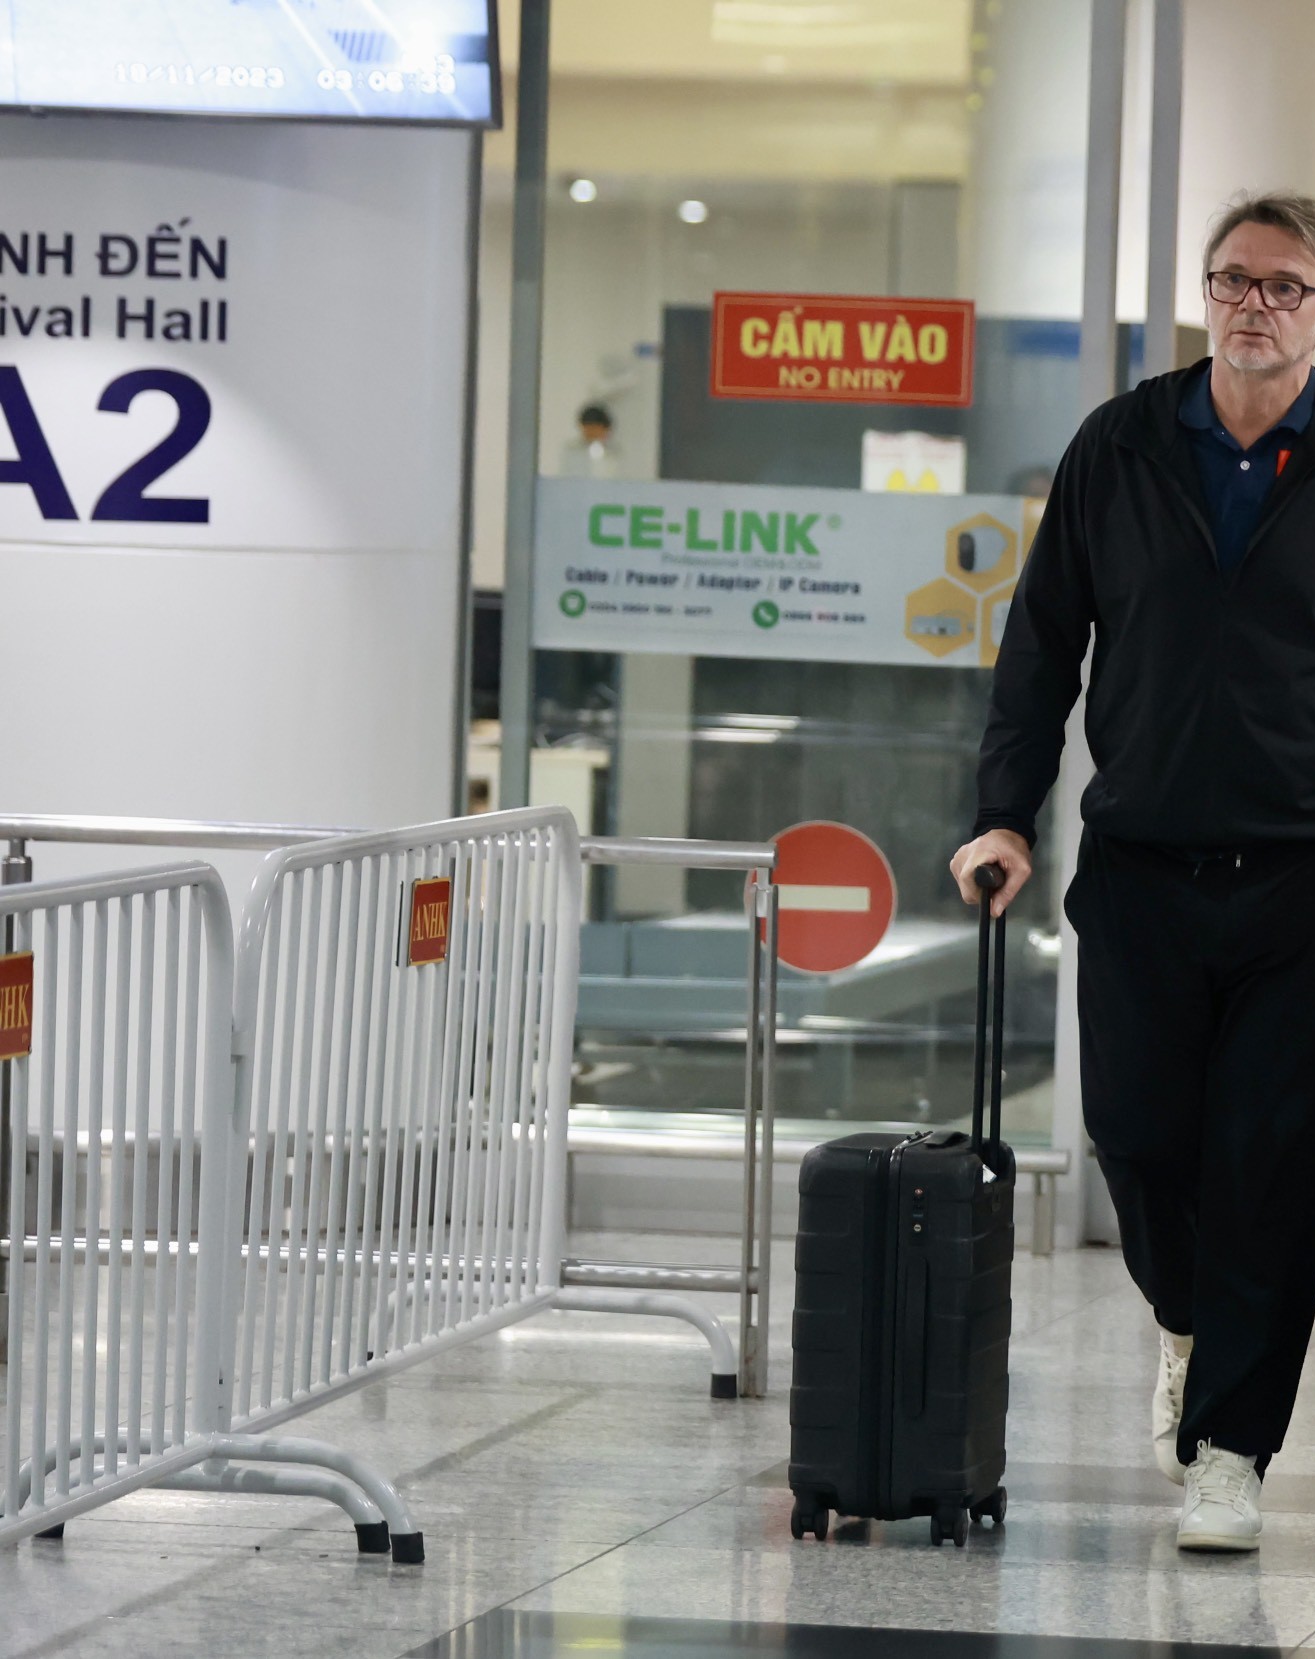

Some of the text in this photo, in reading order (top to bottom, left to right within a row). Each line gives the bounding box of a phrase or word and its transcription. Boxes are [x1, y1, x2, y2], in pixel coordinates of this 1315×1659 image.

[95, 217, 227, 279] ĐẾN
[117, 297, 227, 341] Hall
[858, 315, 948, 365] VÀO
[778, 366, 904, 391] NO ENTRY
[564, 566, 608, 585] Cable
[625, 569, 678, 587] Power
[779, 576, 795, 591] IP
[799, 577, 861, 594] Camera
[412, 901, 448, 941] ANHK
[0, 984, 30, 1031] HK
